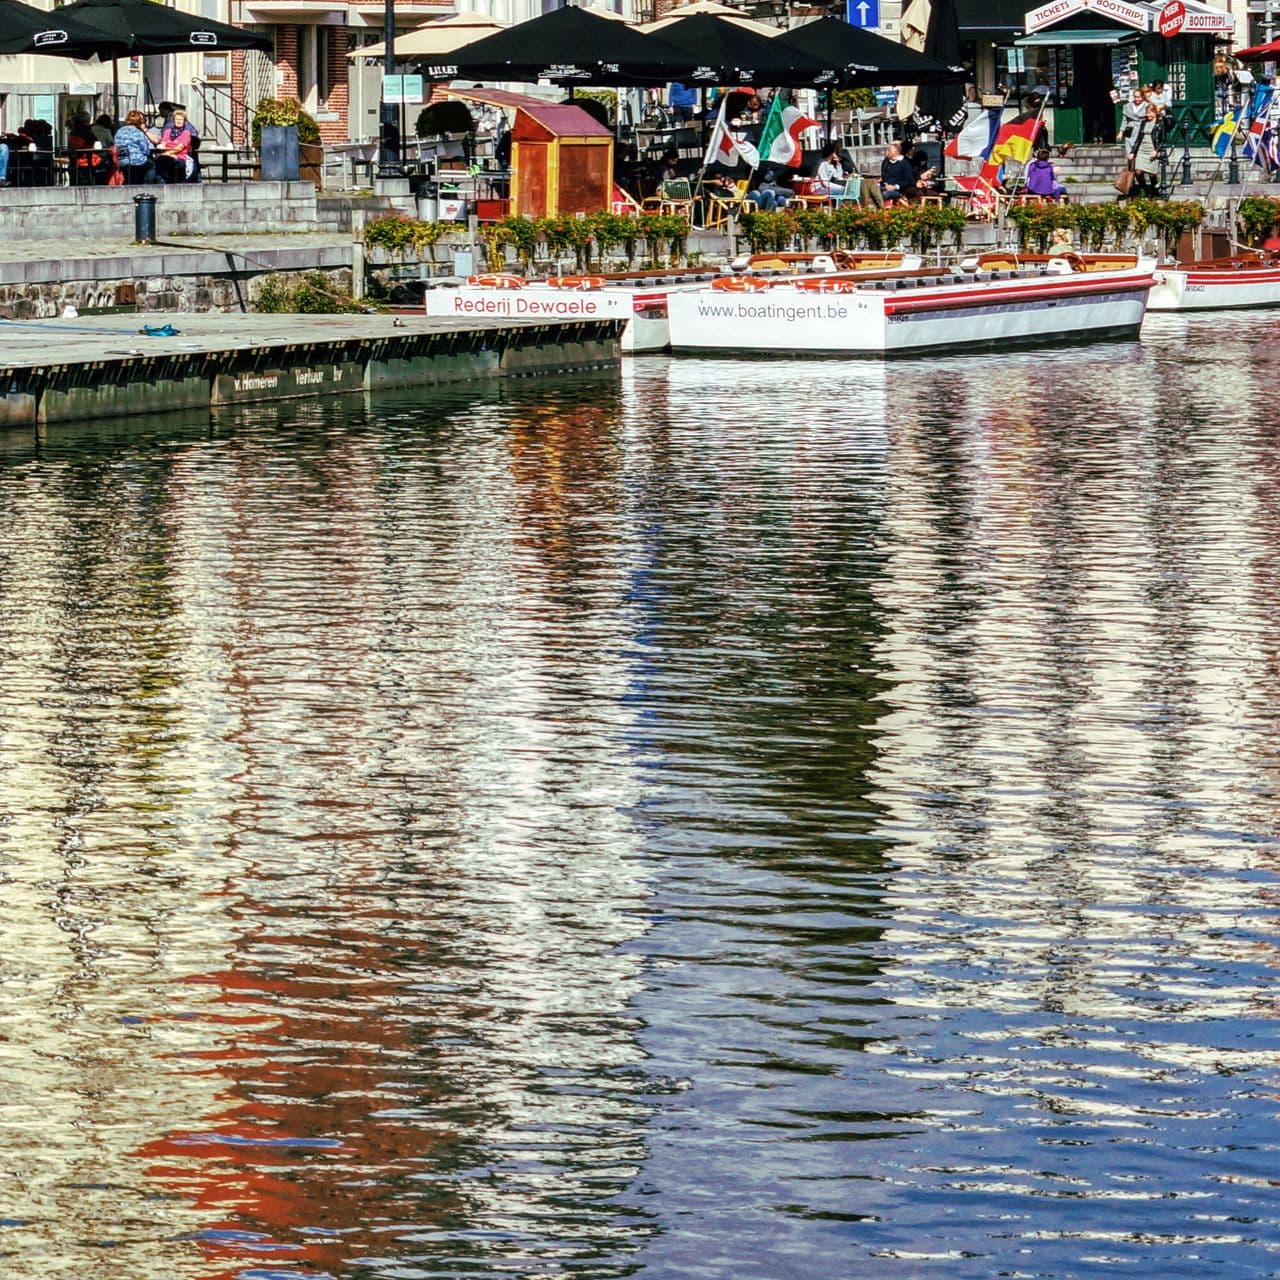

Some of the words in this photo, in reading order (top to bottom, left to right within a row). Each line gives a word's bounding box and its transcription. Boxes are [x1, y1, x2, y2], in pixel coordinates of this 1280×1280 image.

[1034, 0, 1070, 22] TICKETS
[1164, 4, 1180, 18] HIER
[1189, 15, 1225, 27] BOOTTRIPS
[428, 66, 458, 75] LILLET
[454, 297, 511, 316] Rederij
[516, 298, 597, 314] Dewaele
[698, 304, 848, 321] www.boatingent.be
[242, 373, 278, 390] Hameren
[295, 368, 324, 386] Verhuur
